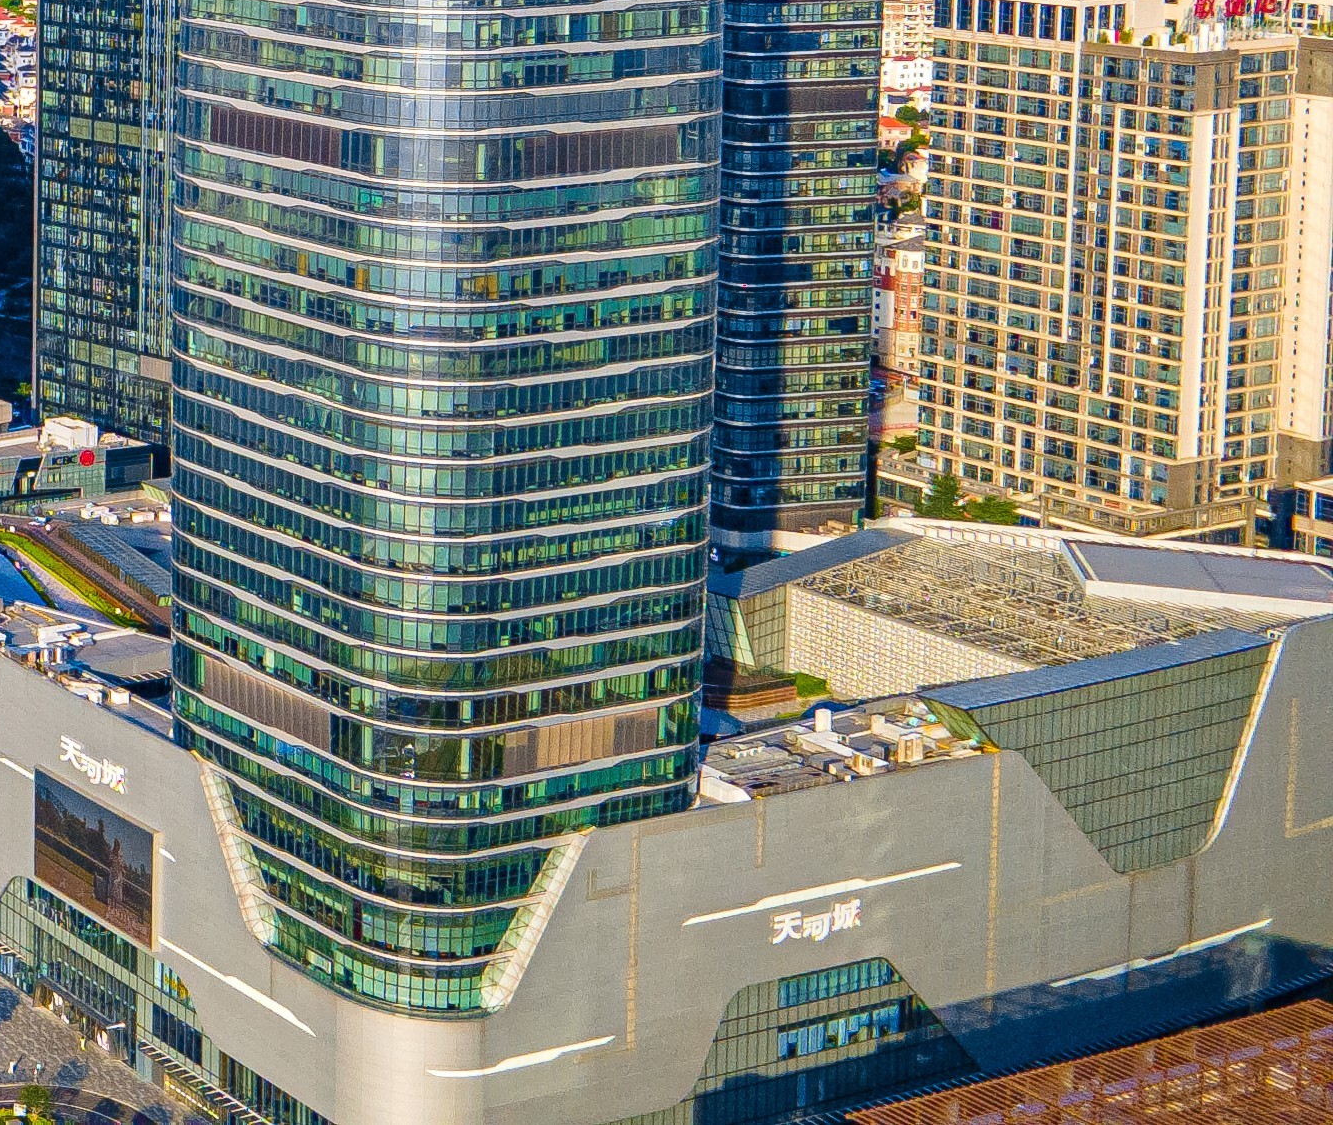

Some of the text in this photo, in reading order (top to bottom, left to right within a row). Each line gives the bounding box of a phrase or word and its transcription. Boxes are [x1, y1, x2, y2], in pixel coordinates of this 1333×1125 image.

[59, 734, 126, 795] 天河城
[771, 898, 862, 945] 天河城
